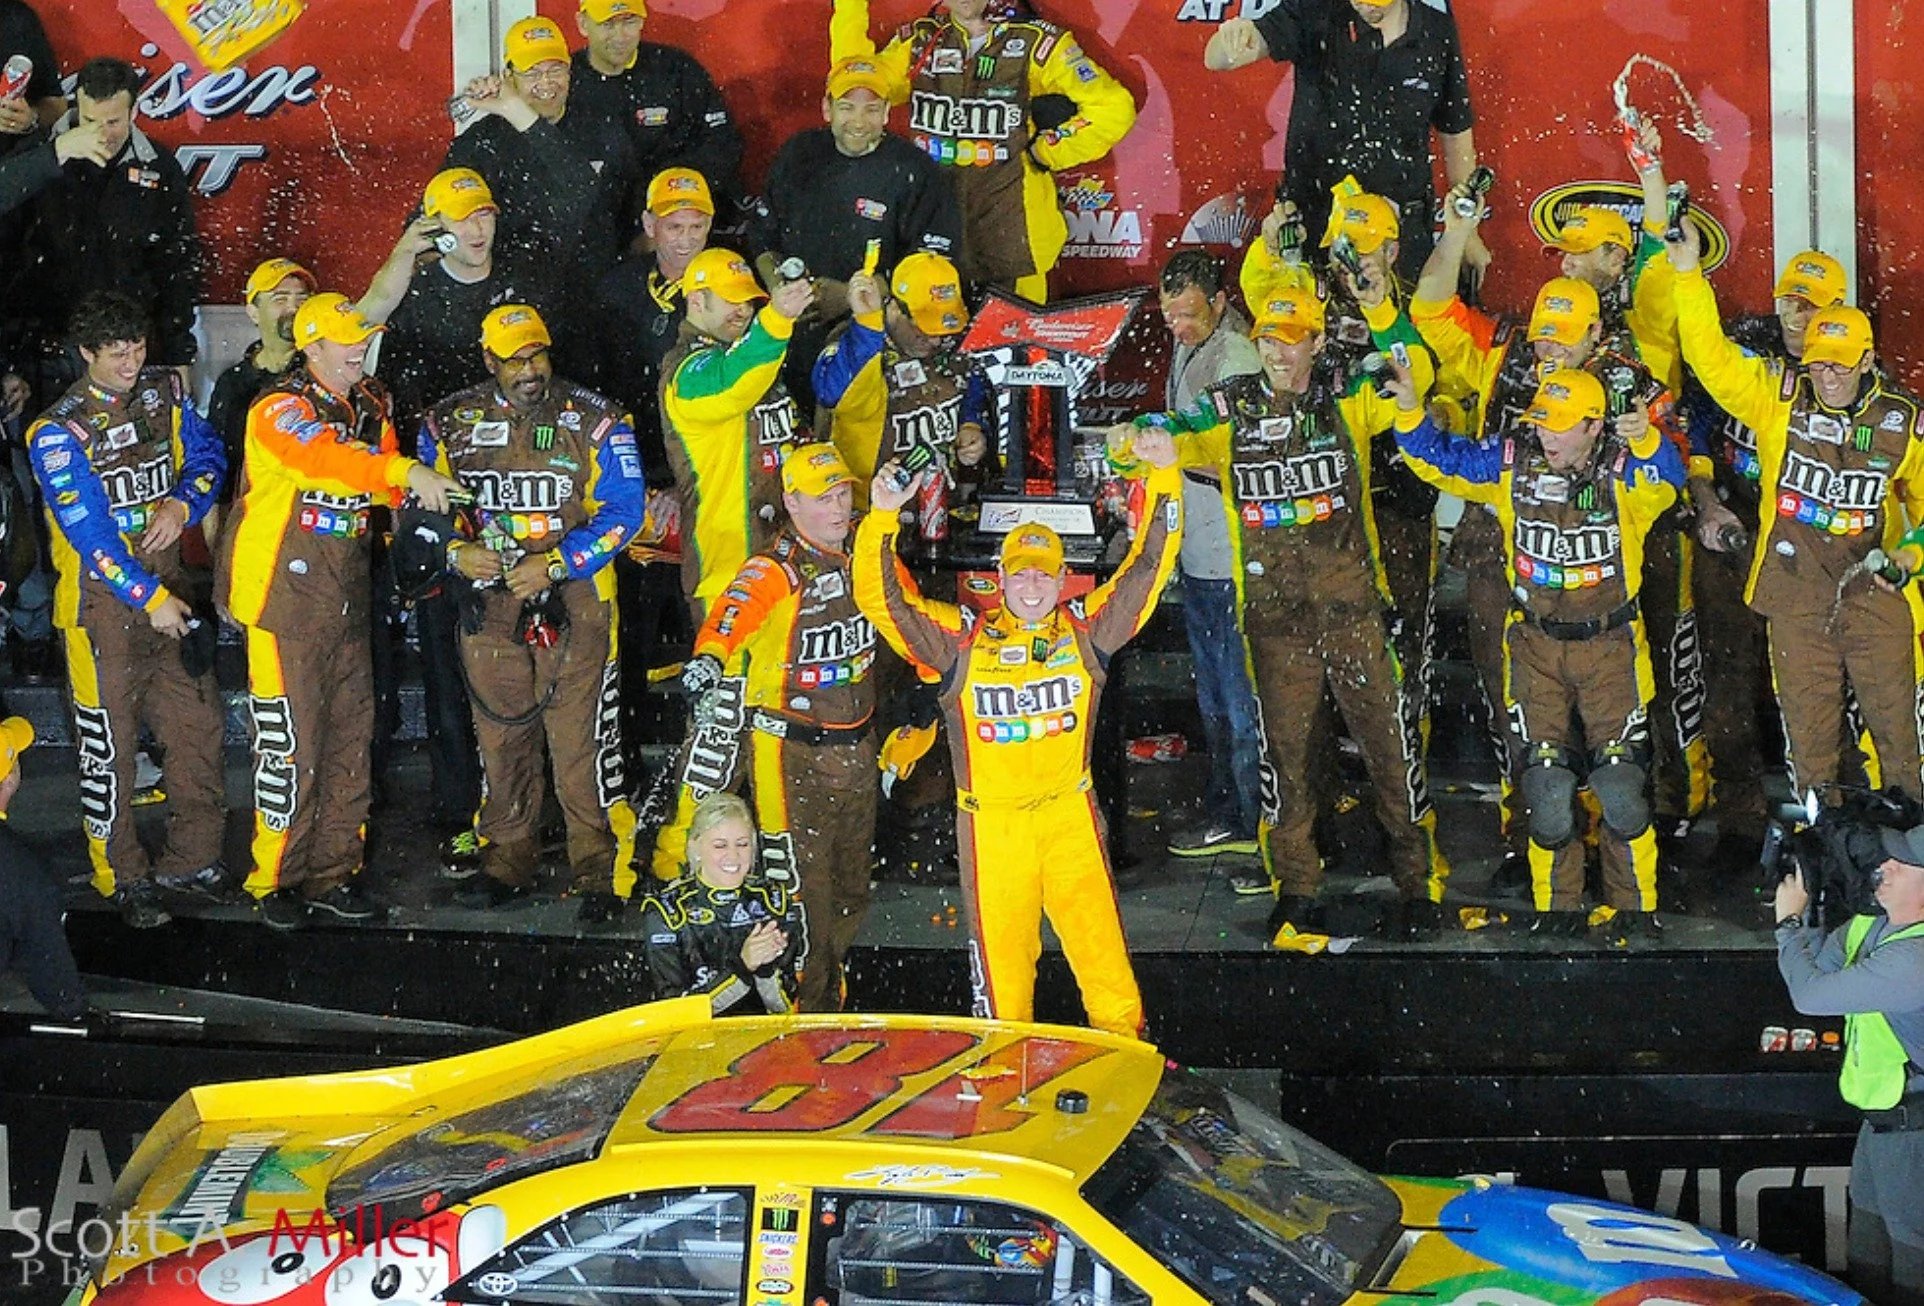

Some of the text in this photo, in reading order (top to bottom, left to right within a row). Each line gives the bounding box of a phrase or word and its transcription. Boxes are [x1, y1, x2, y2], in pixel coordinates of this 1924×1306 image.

[1061, 245, 1143, 258] SPEEDWAY
[1232, 450, 1349, 500] m&m's
[972, 676, 1083, 718] m&m's
